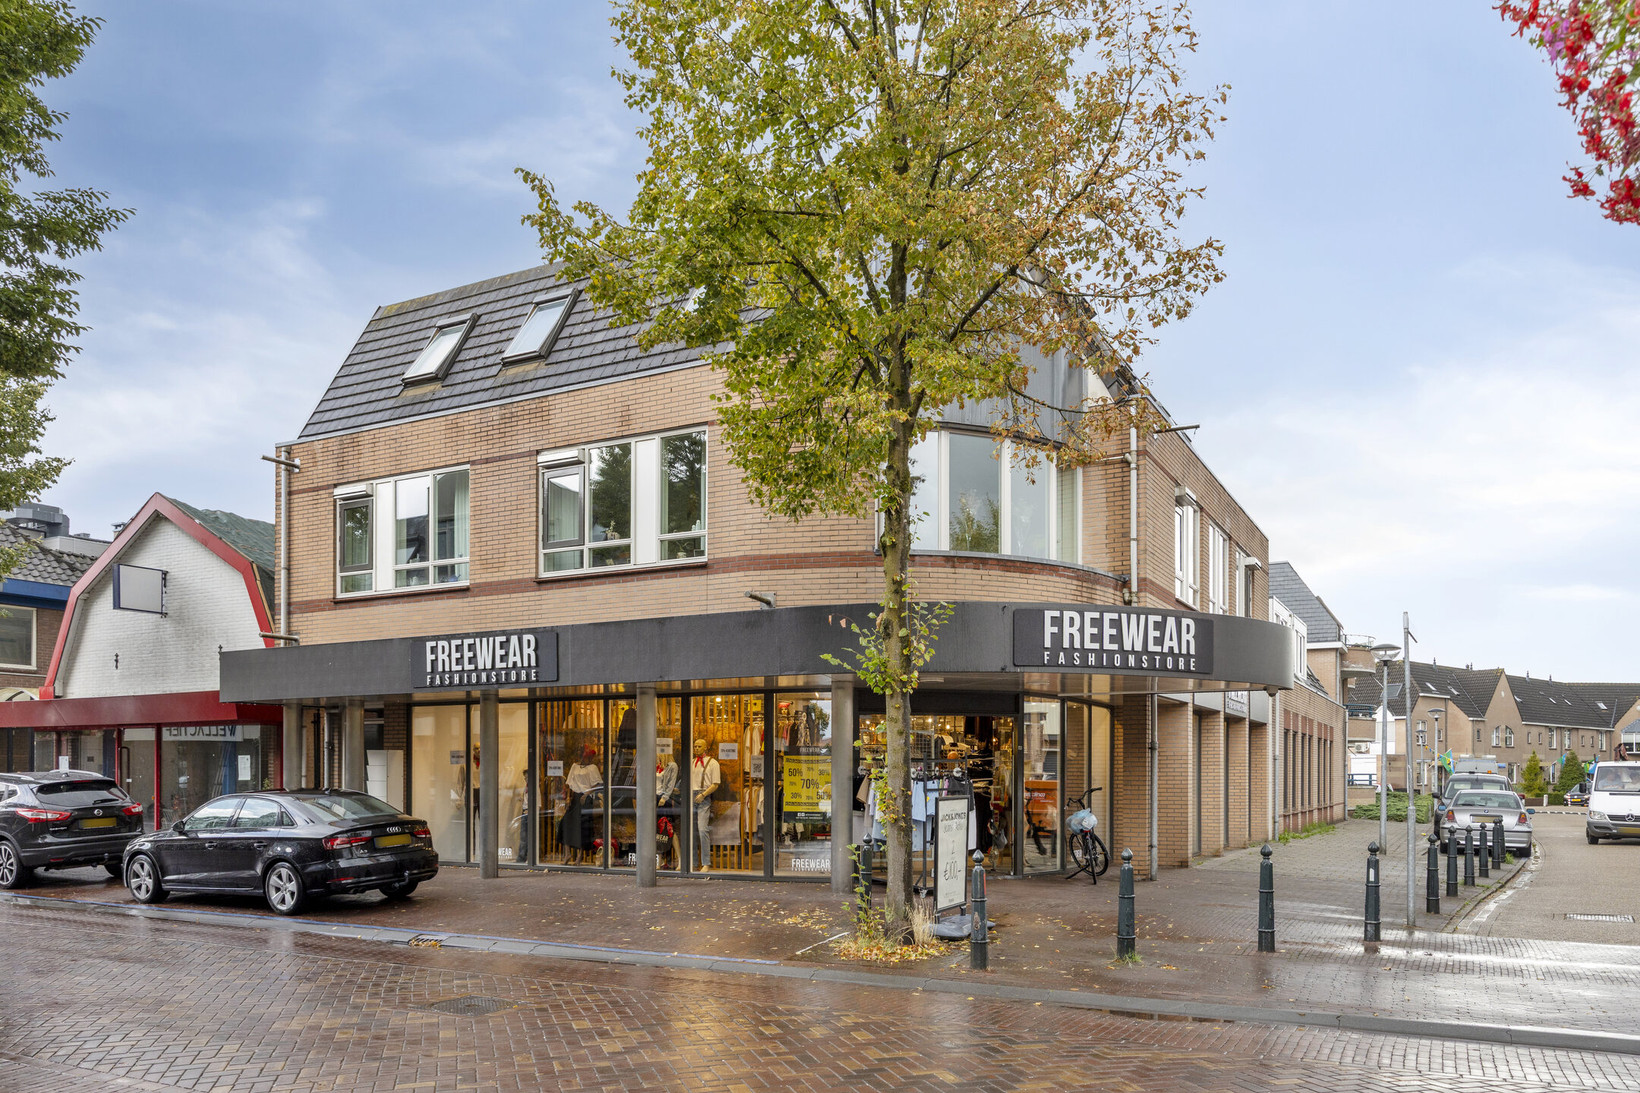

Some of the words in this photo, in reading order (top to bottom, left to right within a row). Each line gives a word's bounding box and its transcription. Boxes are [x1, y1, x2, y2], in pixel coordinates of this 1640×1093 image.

[1043, 610, 1196, 655] FREEWEAR
[425, 634, 537, 673] FREEWEAR
[1044, 651, 1196, 671] FASHIONSTORE
[426, 669, 537, 686] FASHIONSTORE
[788, 768, 803, 777] 50%
[800, 778, 820, 789] 70%
[791, 858, 831, 868] FREEWEAR
